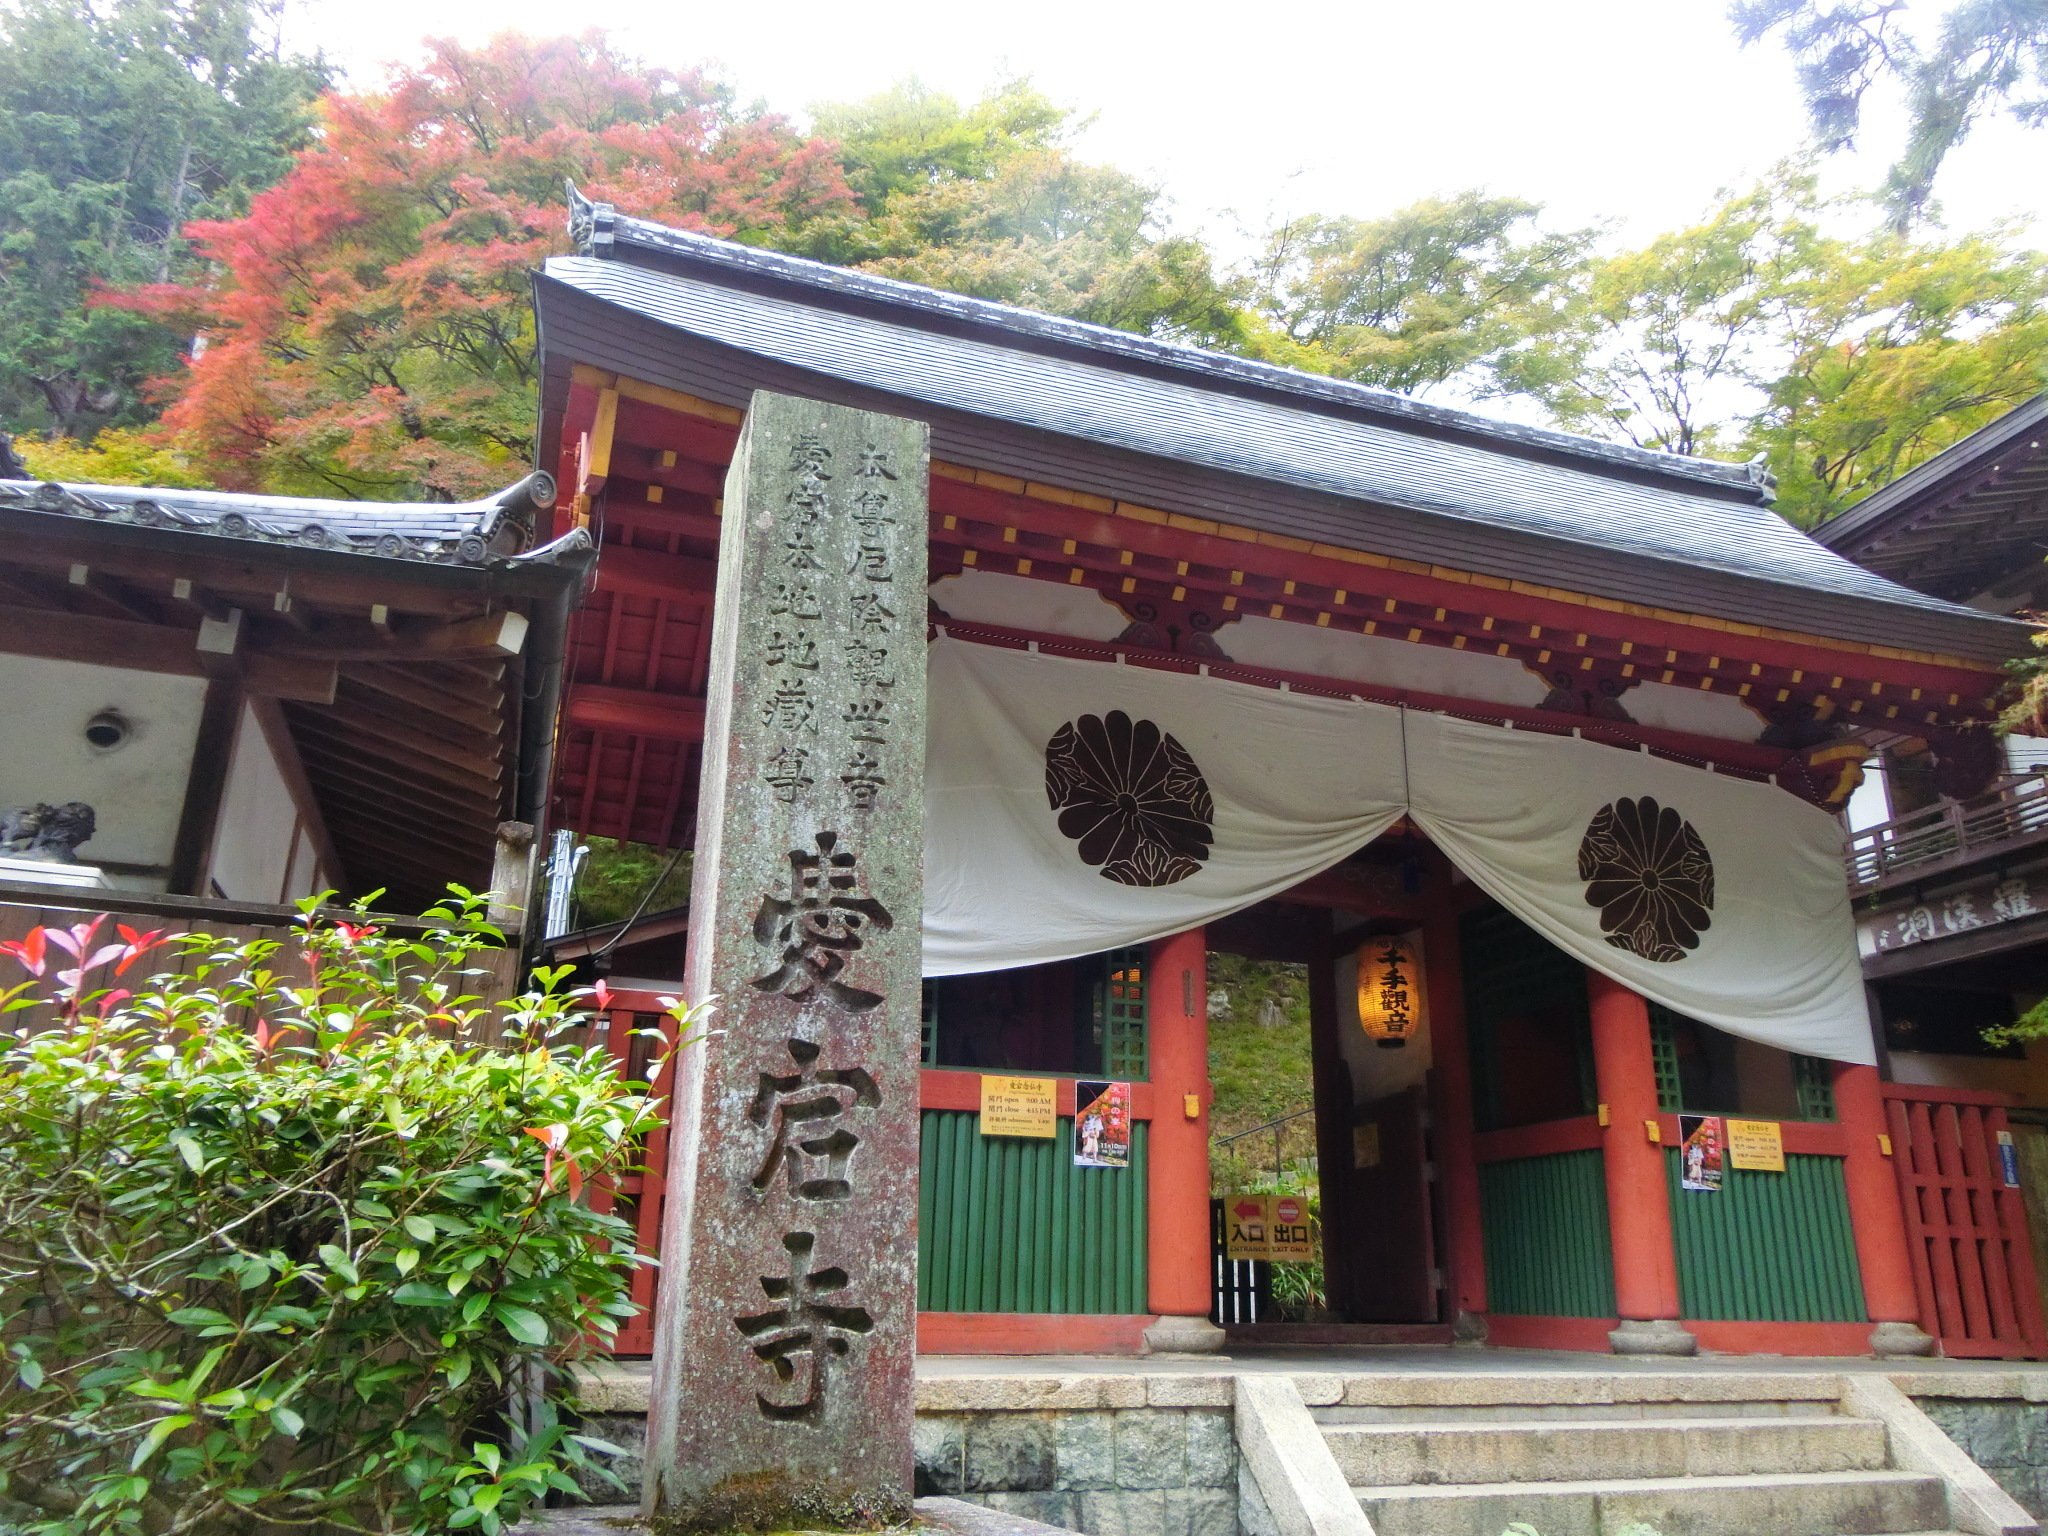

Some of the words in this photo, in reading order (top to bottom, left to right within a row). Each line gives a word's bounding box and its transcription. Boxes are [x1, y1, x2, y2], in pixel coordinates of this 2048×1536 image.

[733, 830, 894, 1421] 愛宕寺
[1232, 1224, 1264, 1242] 入口
[1274, 1224, 1308, 1243] 出口
